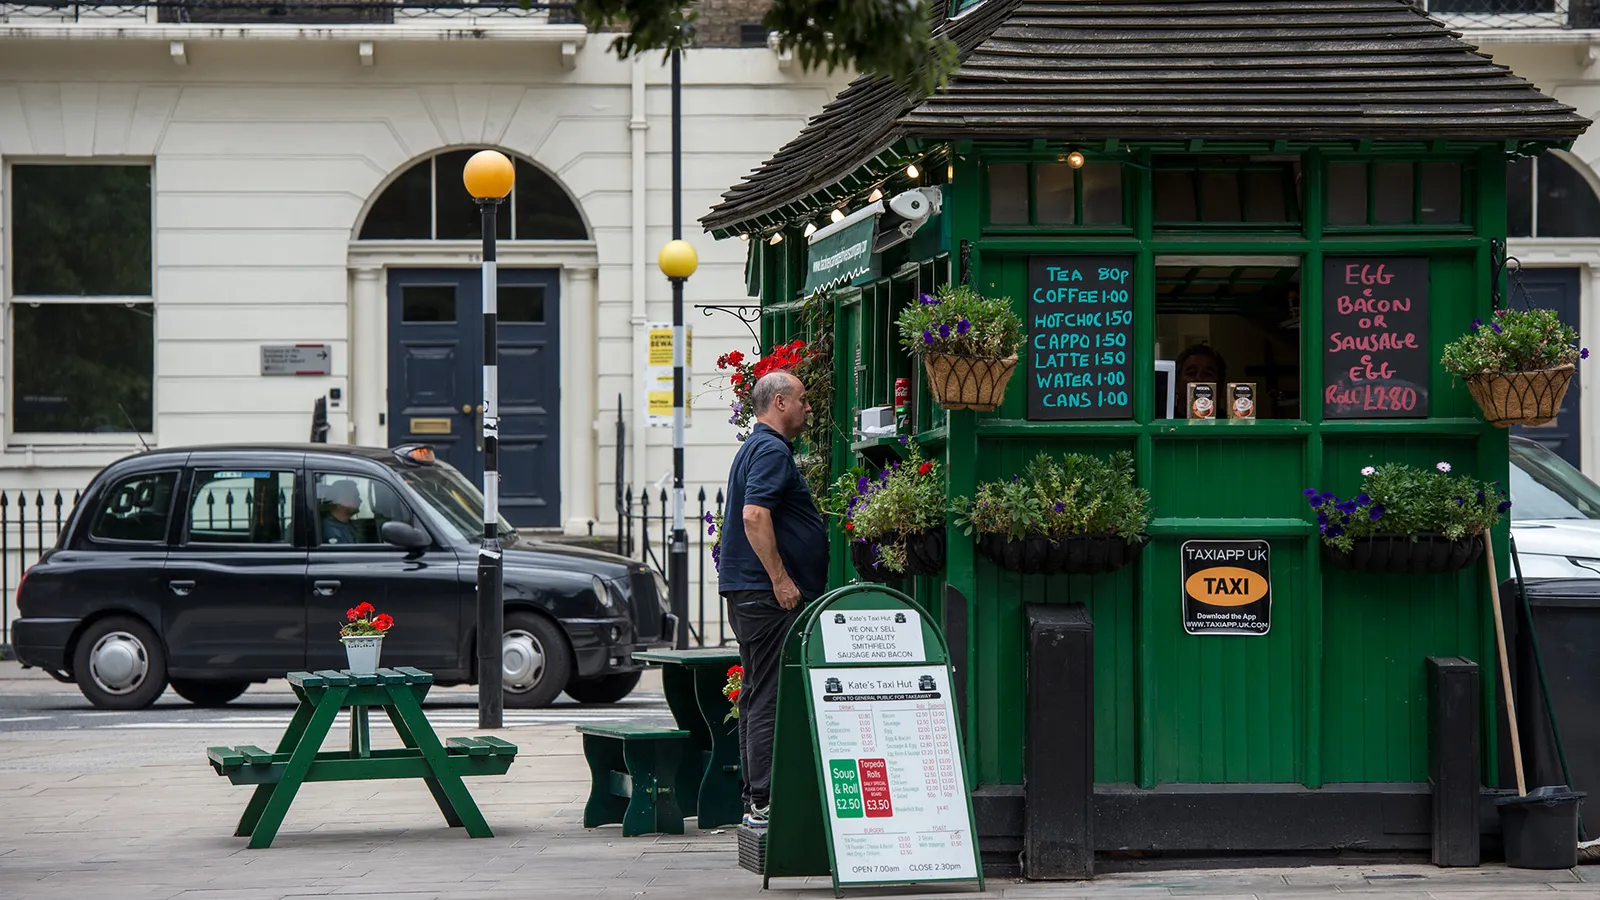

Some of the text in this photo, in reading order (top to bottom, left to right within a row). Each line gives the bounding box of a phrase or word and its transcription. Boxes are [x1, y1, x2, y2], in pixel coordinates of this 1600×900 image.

[1046, 266, 1129, 284] TEA 80p
[1345, 264, 1394, 284] EGG
[1033, 288, 1098, 304] COFFEE
[1338, 296, 1411, 314] BACON
[1358, 315, 1387, 328] OR
[1034, 333, 1090, 349] CAPPO
[1035, 352, 1089, 368] LATTE
[1349, 362, 1396, 382] EGG
[1036, 372, 1094, 388] WATER
[1043, 392, 1092, 408] CANS
[1186, 549, 1266, 560] TAXIAPP UK
[1204, 578, 1248, 594] TAXI
[847, 680, 874, 689] Kate's
[876, 680, 894, 688] Taxi
[860, 759, 884, 769] Torpedo
[832, 767, 855, 781] Soup
[833, 782, 858, 794] & Roll
[836, 798, 861, 810] £2.50
[866, 799, 890, 810] £3.50
[851, 864, 900, 873] OPEN 7.00am
[908, 862, 962, 871] CLOSE 2.30pm
